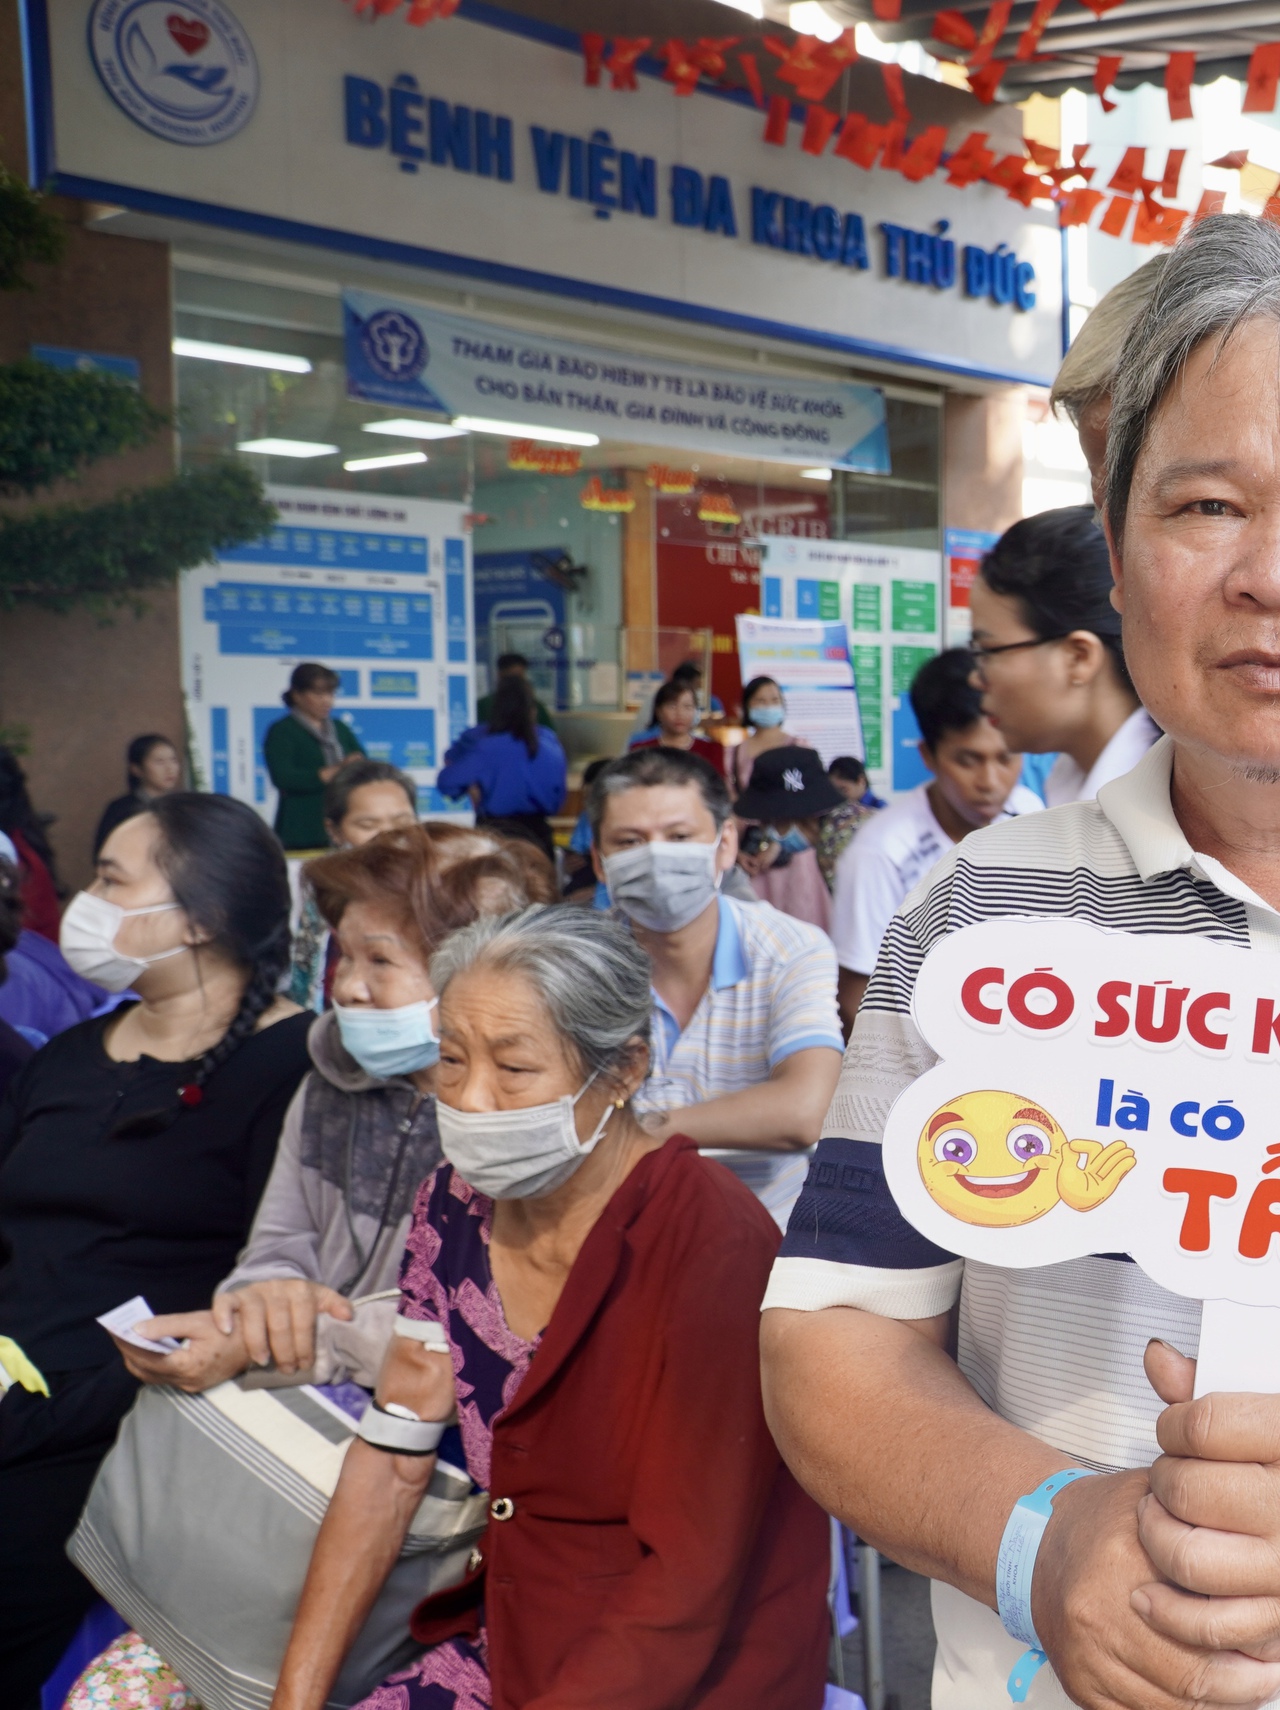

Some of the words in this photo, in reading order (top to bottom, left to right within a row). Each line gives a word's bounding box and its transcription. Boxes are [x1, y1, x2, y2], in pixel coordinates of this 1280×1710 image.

[343, 72, 515, 184] BỆNH
[529, 129, 657, 220] VIỆN
[670, 164, 737, 237] ĐA
[751, 185, 869, 271] KHOA
[879, 219, 954, 290] THỦ
[963, 242, 1035, 312] ĐỨC
[452, 336, 514, 366] THAM
[518, 349, 553, 371] GIA
[651, 372, 660, 390] Y
[475, 374, 519, 400] CHO
[625, 401, 656, 421] GIA
[960, 966, 1075, 1030] CÓ
[1094, 980, 1231, 1050] SỨC
[1096, 1078, 1150, 1132] là
[1170, 1099, 1245, 1141] có
